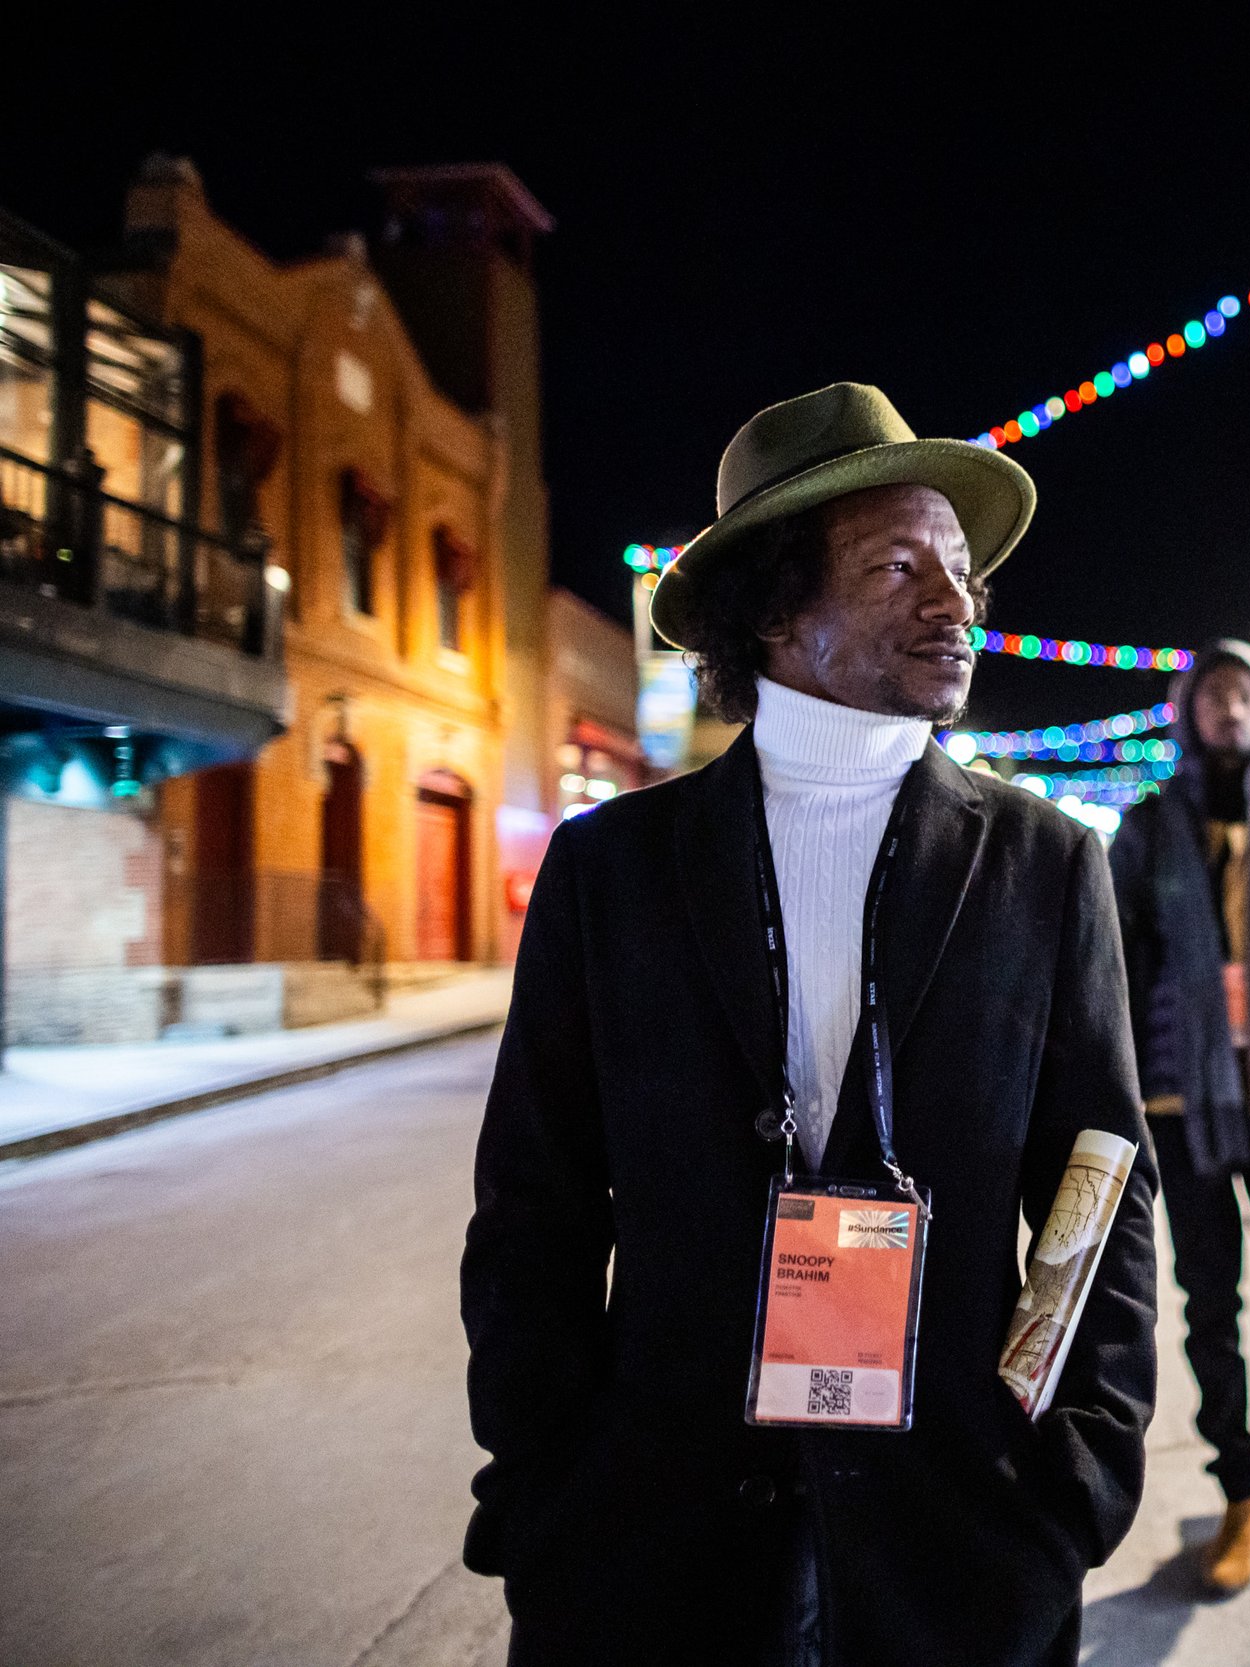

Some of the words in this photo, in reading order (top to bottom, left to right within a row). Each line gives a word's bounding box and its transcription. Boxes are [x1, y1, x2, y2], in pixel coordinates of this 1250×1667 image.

[848, 1224, 903, 1234] #Sundance
[778, 1253, 835, 1268] SNOOPY
[776, 1268, 830, 1282] BRAHIM
